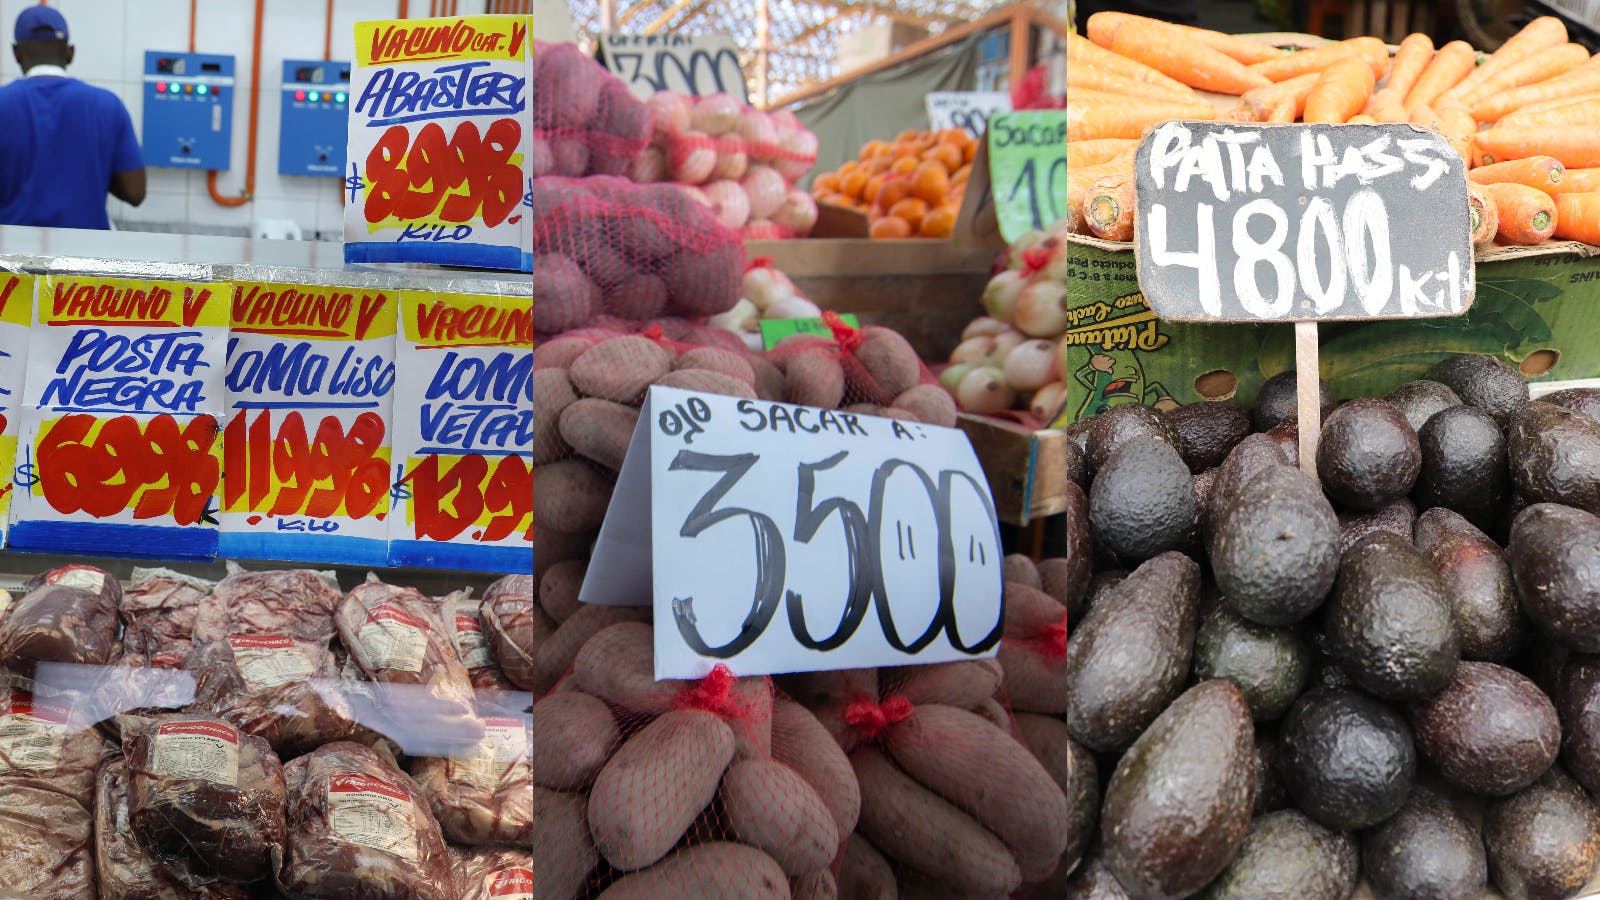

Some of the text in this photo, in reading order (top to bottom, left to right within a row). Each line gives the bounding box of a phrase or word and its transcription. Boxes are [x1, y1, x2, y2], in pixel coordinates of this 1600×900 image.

[370, 20, 475, 61] VACUNO
[1300, 128, 1451, 192] HASS
[1148, 188, 1392, 316] 4800
[52, 282, 172, 320] VACUNO
[182, 286, 213, 328] V
[232, 285, 387, 341] VACUNO V
[56, 328, 211, 377] POSTA
[425, 351, 533, 404] LOM
[36, 364, 206, 412] NEGRA
[658, 397, 927, 445] OJO SACAR A:
[667, 449, 1005, 660] 3500
